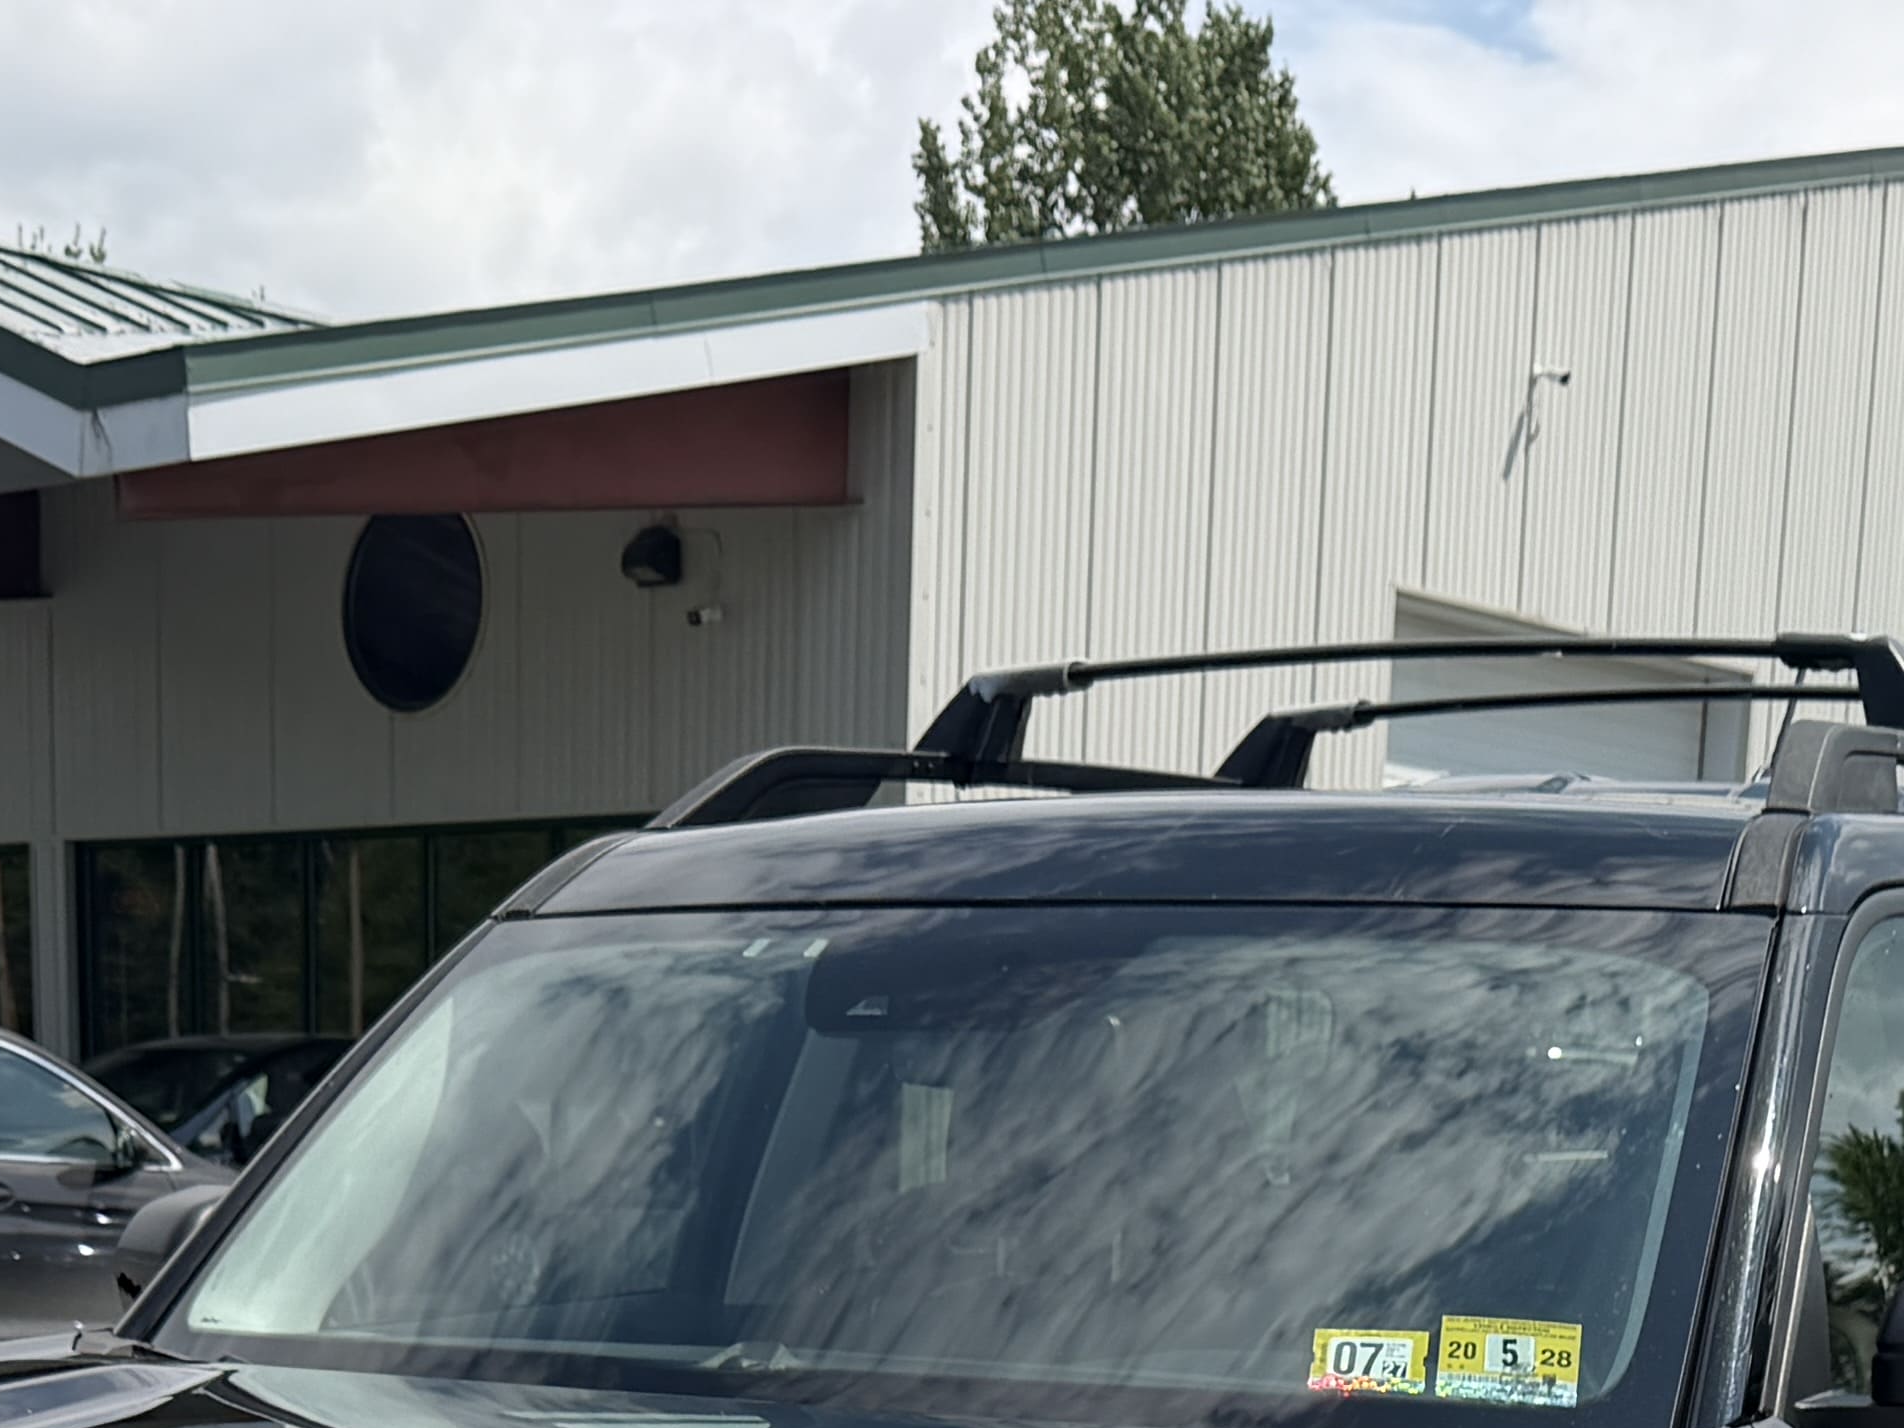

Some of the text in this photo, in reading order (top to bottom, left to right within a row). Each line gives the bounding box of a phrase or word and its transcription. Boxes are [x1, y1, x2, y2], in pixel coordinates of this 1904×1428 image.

[1332, 1341, 1385, 1376] 07
[1447, 1338, 1573, 1368] 20 5 28
[1382, 1360, 1408, 1379] 27
